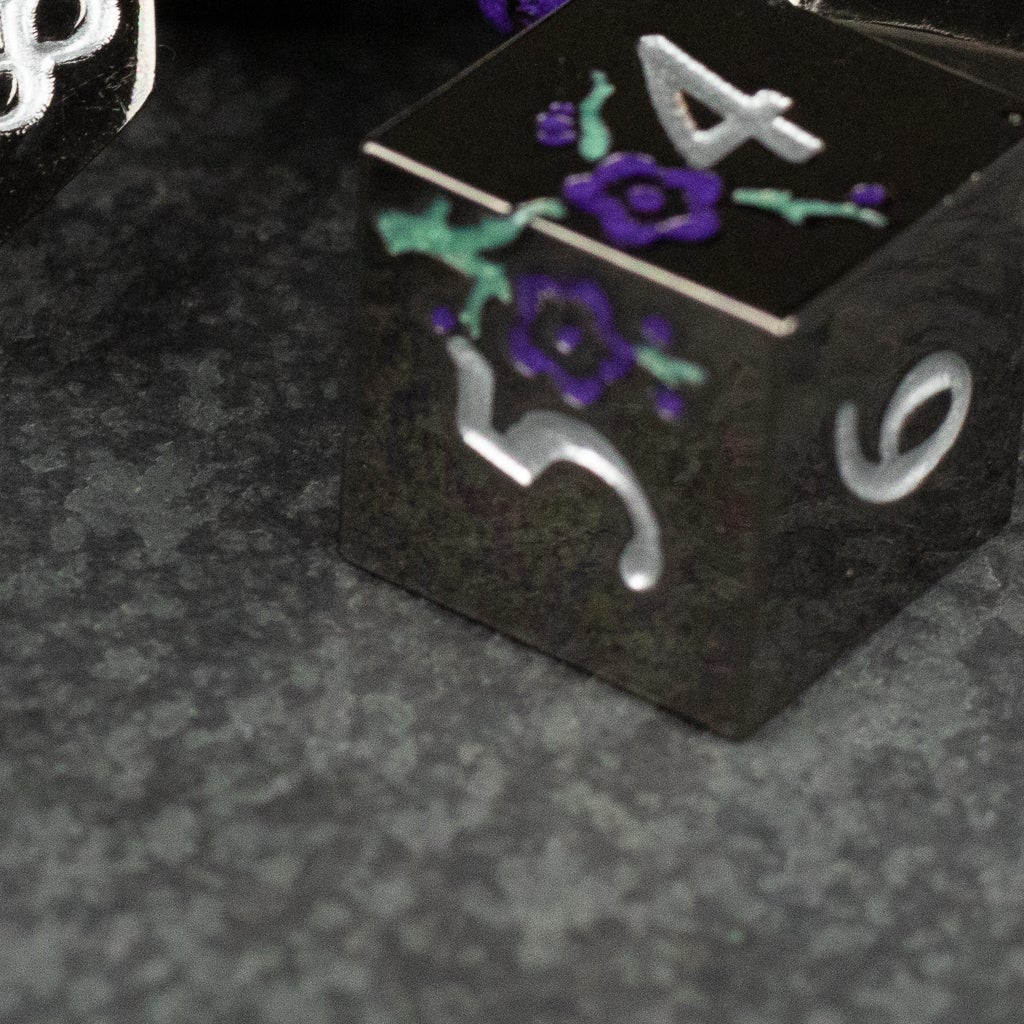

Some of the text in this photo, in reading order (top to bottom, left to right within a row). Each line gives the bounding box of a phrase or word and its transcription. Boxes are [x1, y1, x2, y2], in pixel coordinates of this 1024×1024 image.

[637, 33, 823, 169] 4
[447, 336, 663, 592] 5
[834, 351, 972, 504] 6
